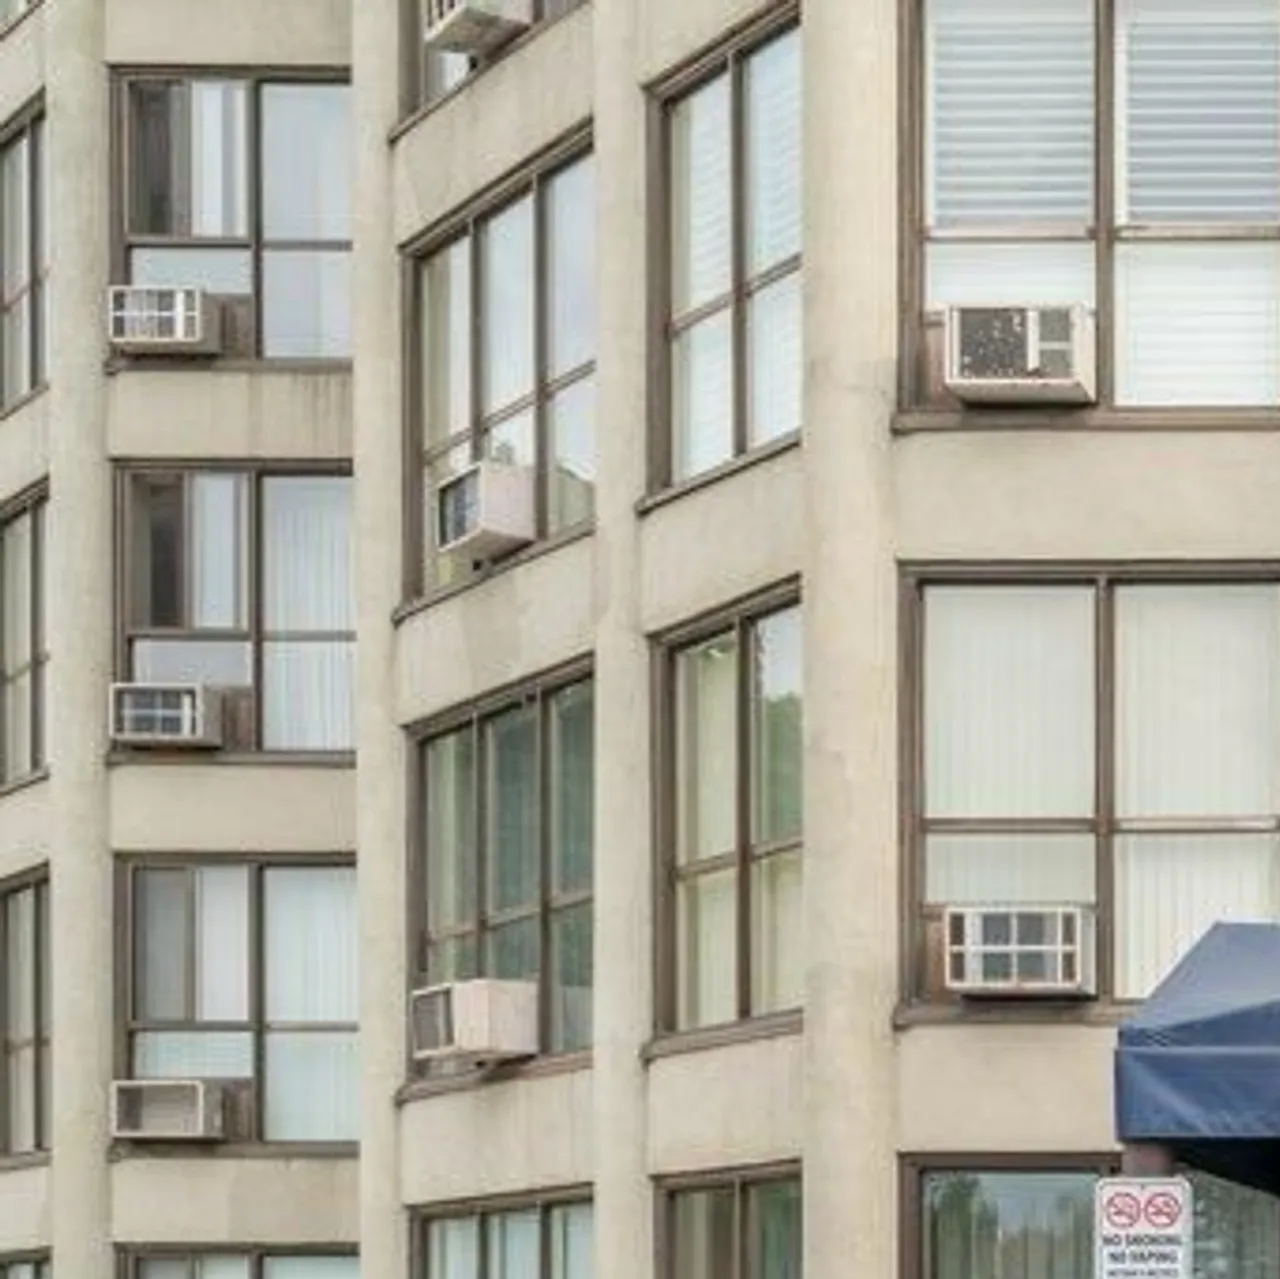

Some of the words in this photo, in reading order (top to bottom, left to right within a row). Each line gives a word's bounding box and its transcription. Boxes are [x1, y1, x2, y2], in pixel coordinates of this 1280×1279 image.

[1102, 1233, 1122, 1247] NO
[1108, 1250, 1127, 1264] NO
[1130, 1249, 1179, 1264] VAPING
